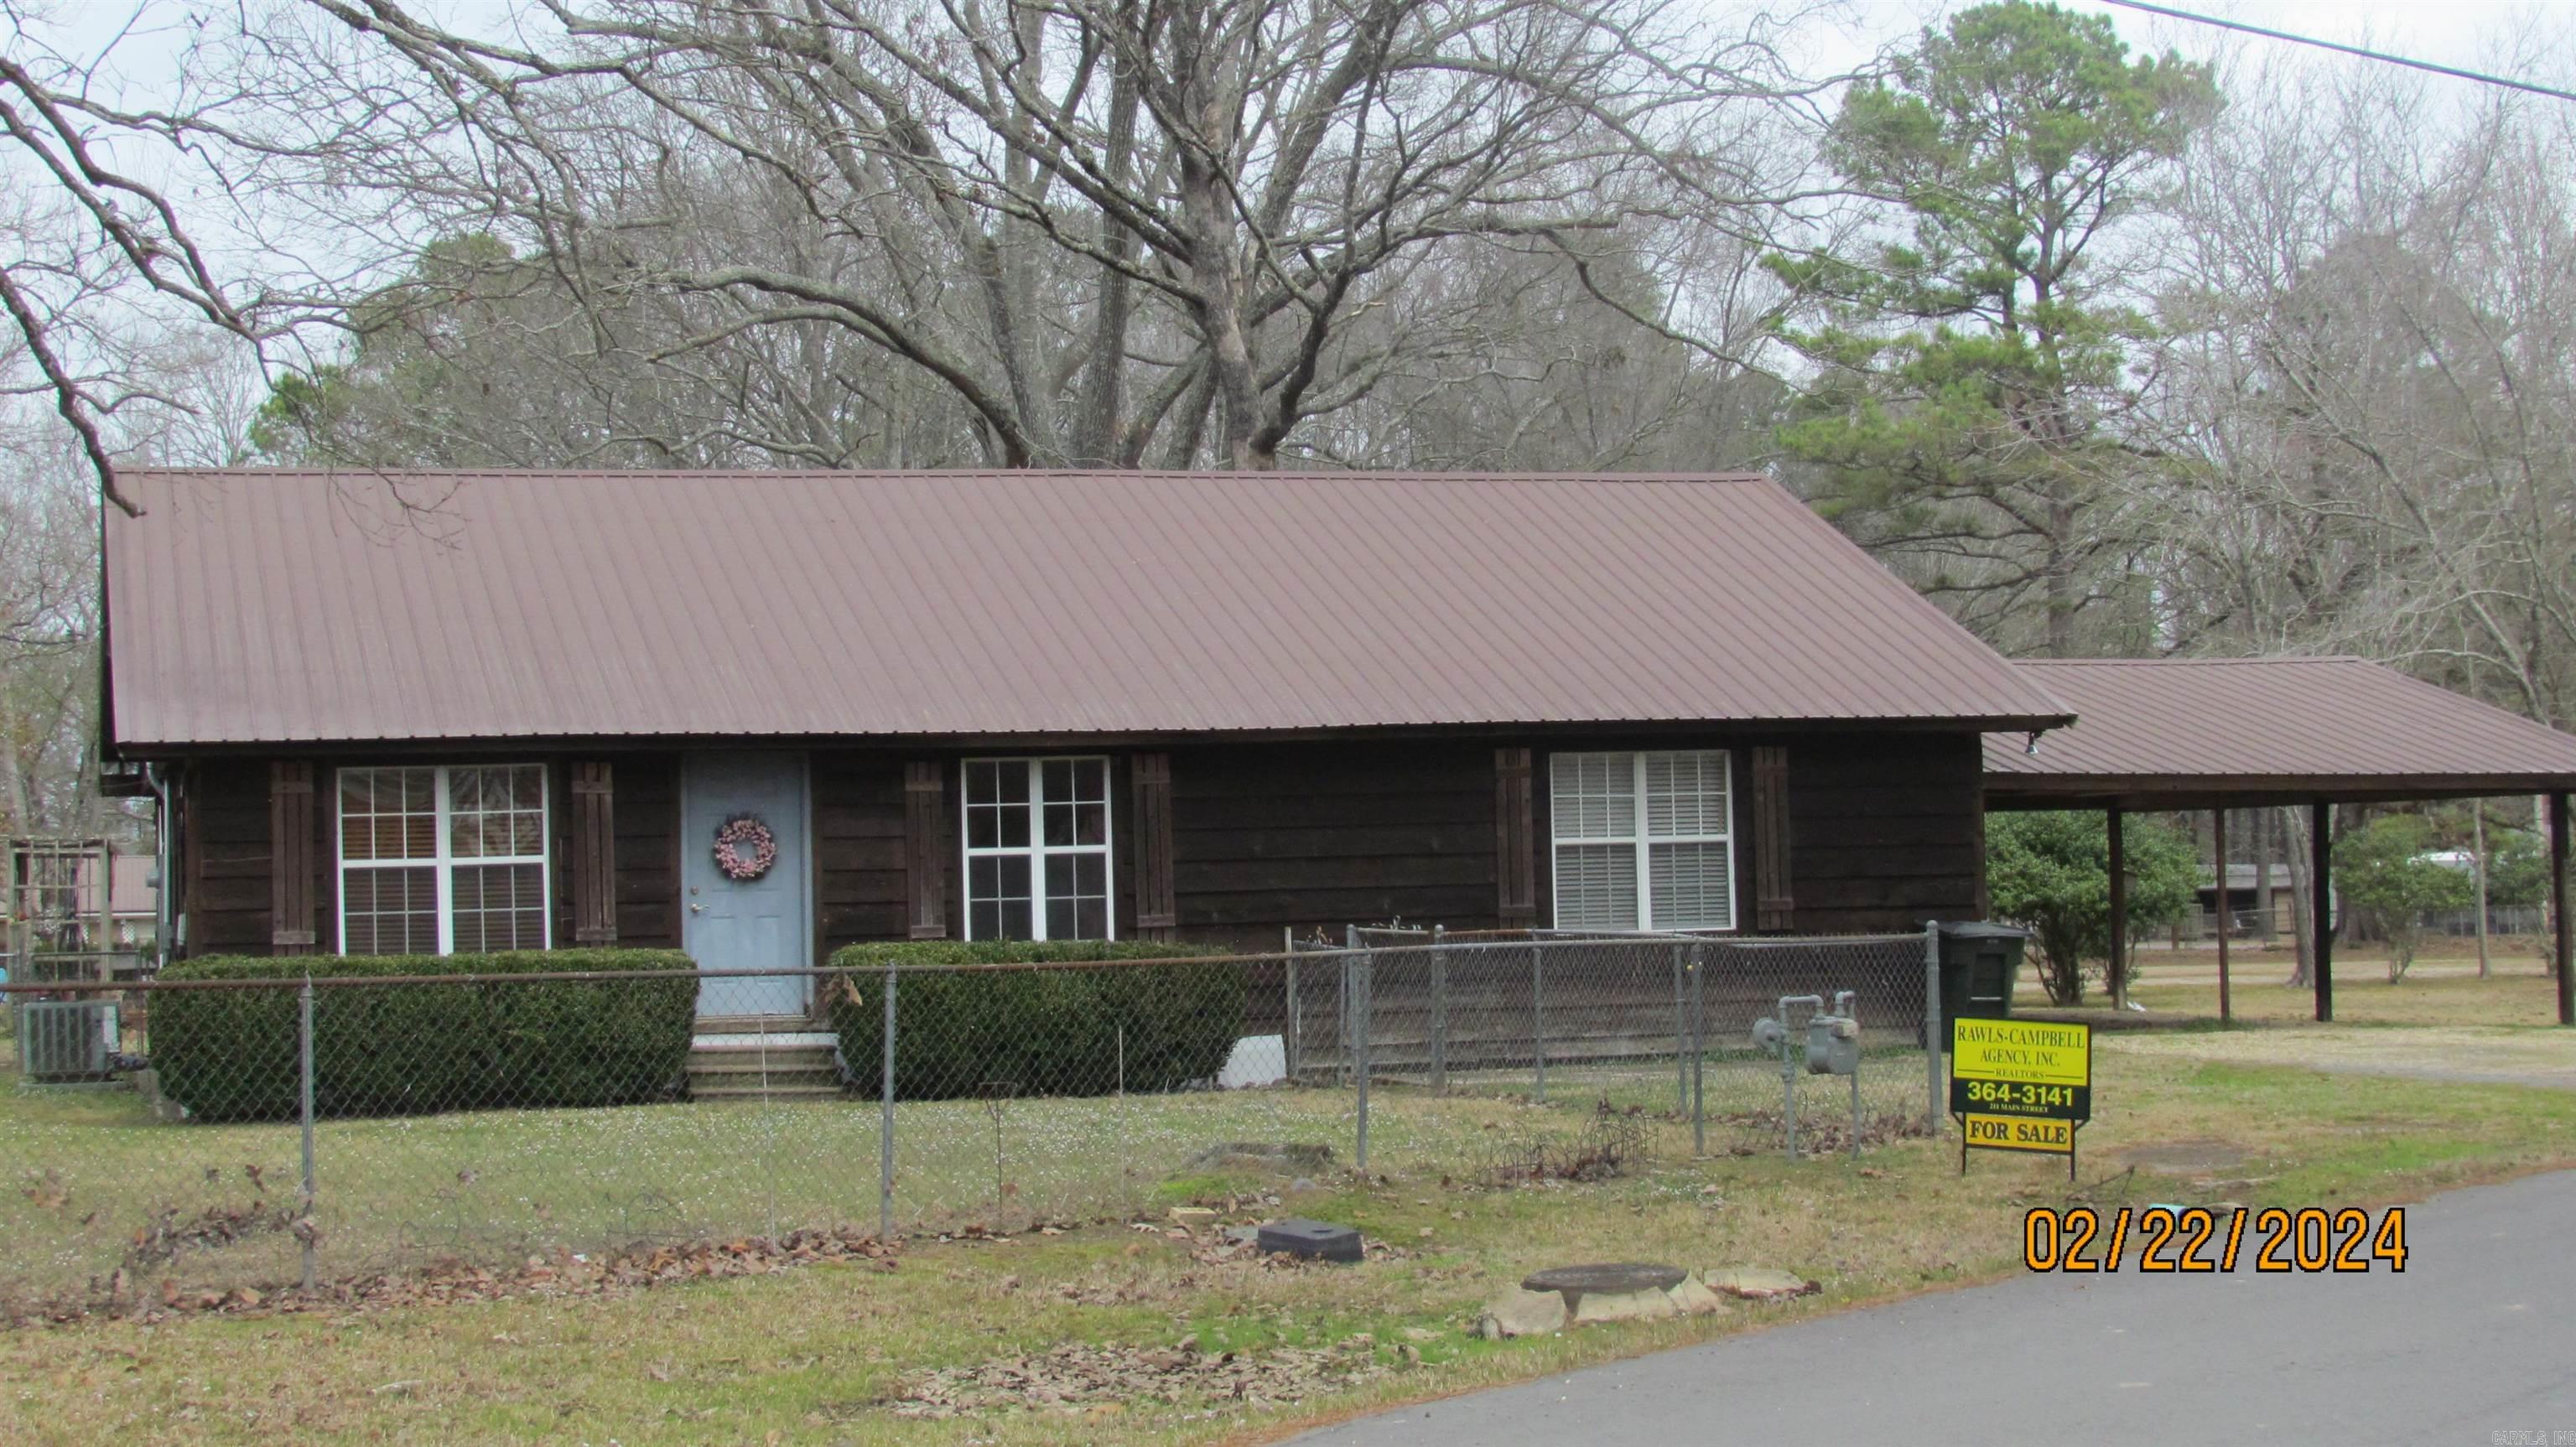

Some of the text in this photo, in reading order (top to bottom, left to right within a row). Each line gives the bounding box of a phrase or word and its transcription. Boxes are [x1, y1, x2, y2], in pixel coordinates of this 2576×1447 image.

[1957, 1025, 2085, 1048] RAWLS-CAMPBELL
[2035, 1052, 2060, 1066] INC.
[1995, 1068, 2045, 1079] REALTORS
[1967, 1081, 2073, 1107] 364-3141
[2001, 1103, 2020, 1112] MAIN
[2021, 1105, 2049, 1113] STREET
[1969, 1120, 2068, 1144] FOR SALE
